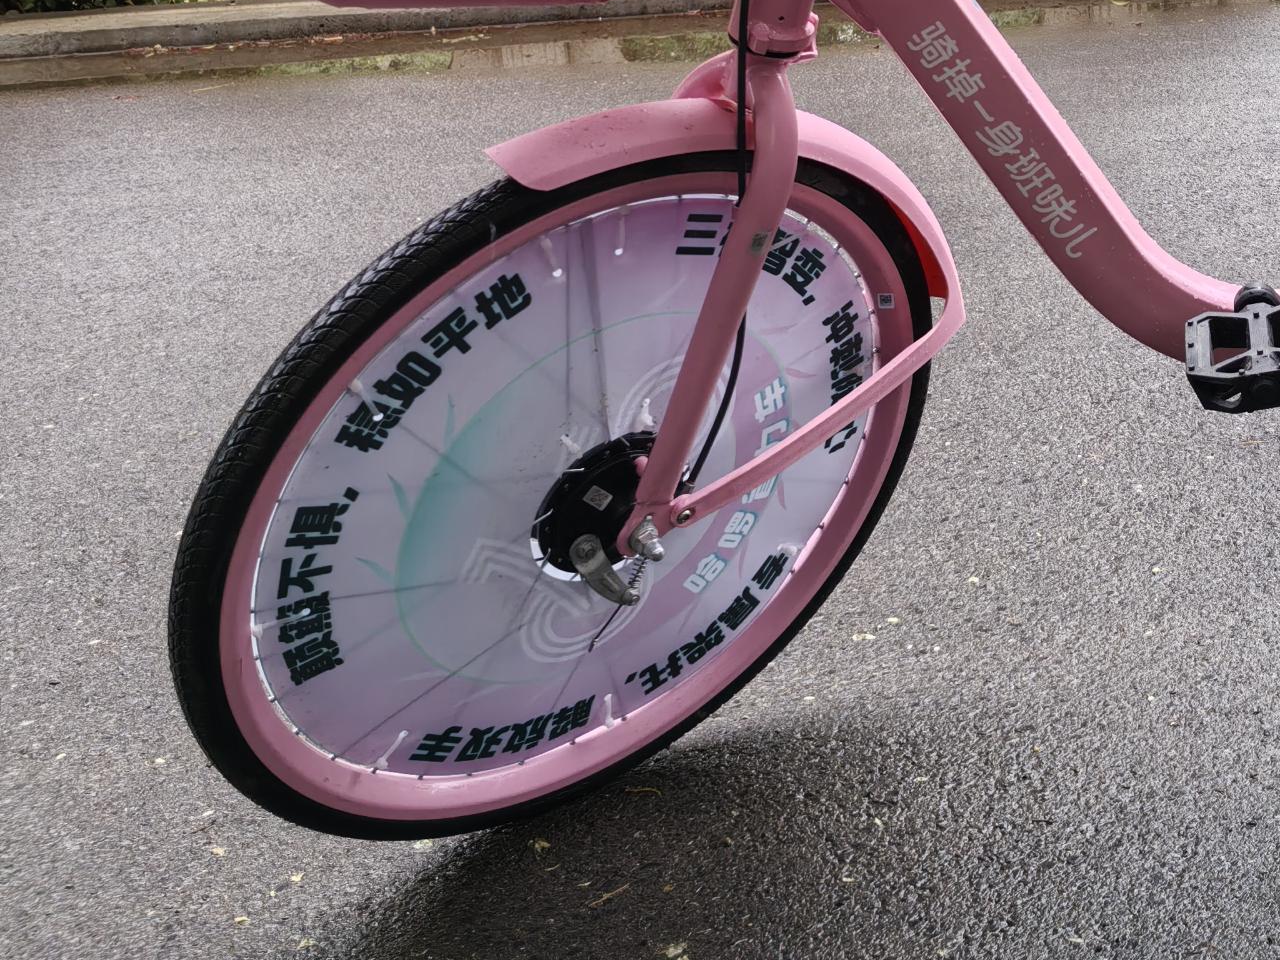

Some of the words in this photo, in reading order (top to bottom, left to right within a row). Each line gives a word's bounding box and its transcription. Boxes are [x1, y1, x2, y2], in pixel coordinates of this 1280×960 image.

[906, 21, 1098, 259] 骑掉一身班味儿
[675, 213, 827, 306] 三智变，
[334, 273, 532, 453] 稳如平地
[409, 694, 596, 762] 解放双手
